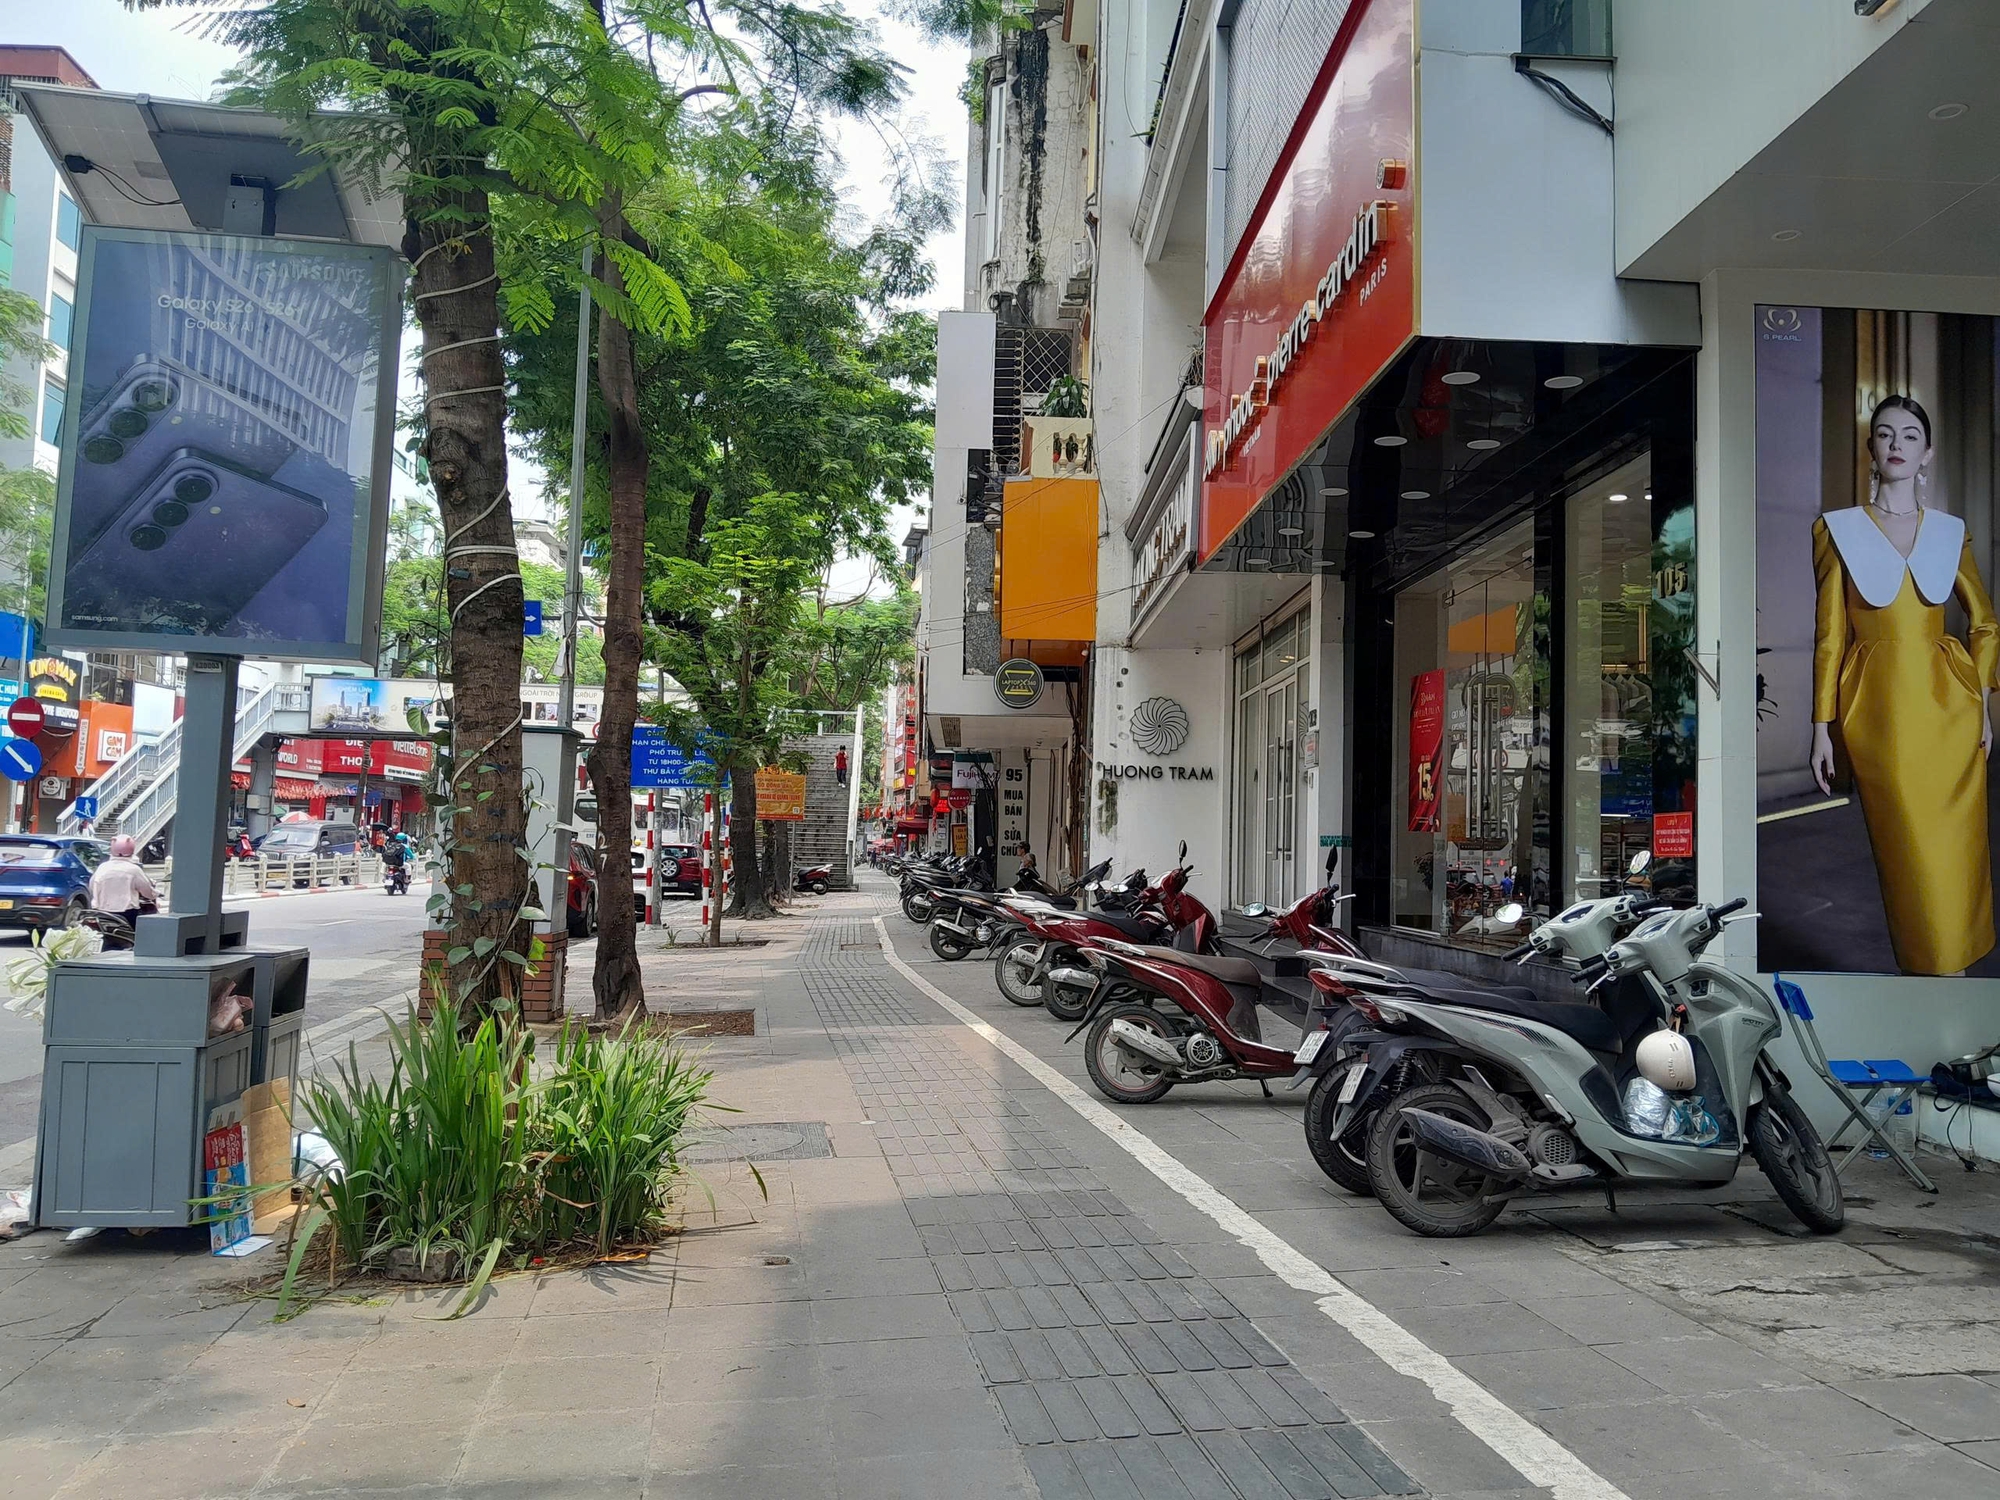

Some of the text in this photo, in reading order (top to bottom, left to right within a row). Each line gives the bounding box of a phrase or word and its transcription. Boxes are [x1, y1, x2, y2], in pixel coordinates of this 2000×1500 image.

[264, 258, 365, 284] SAMSUNG
[1359, 257, 1388, 306] PARIS
[157, 294, 222, 315] Galaxy
[1267, 200, 1378, 405] pierre cardin
[185, 318, 237, 335] Galaxy
[1772, 334, 1802, 342] PEARL
[1655, 562, 1687, 599] 105
[71, 614, 119, 623] samsung.com
[1005, 768, 1023, 782] 95
[1102, 764, 1215, 781] HUONG TRAM
[657, 776, 679, 785] HÀNG
[1004, 789, 1024, 801] MUA
[1004, 805, 1022, 816] BÁN
[1004, 827, 1022, 841] SỬA
